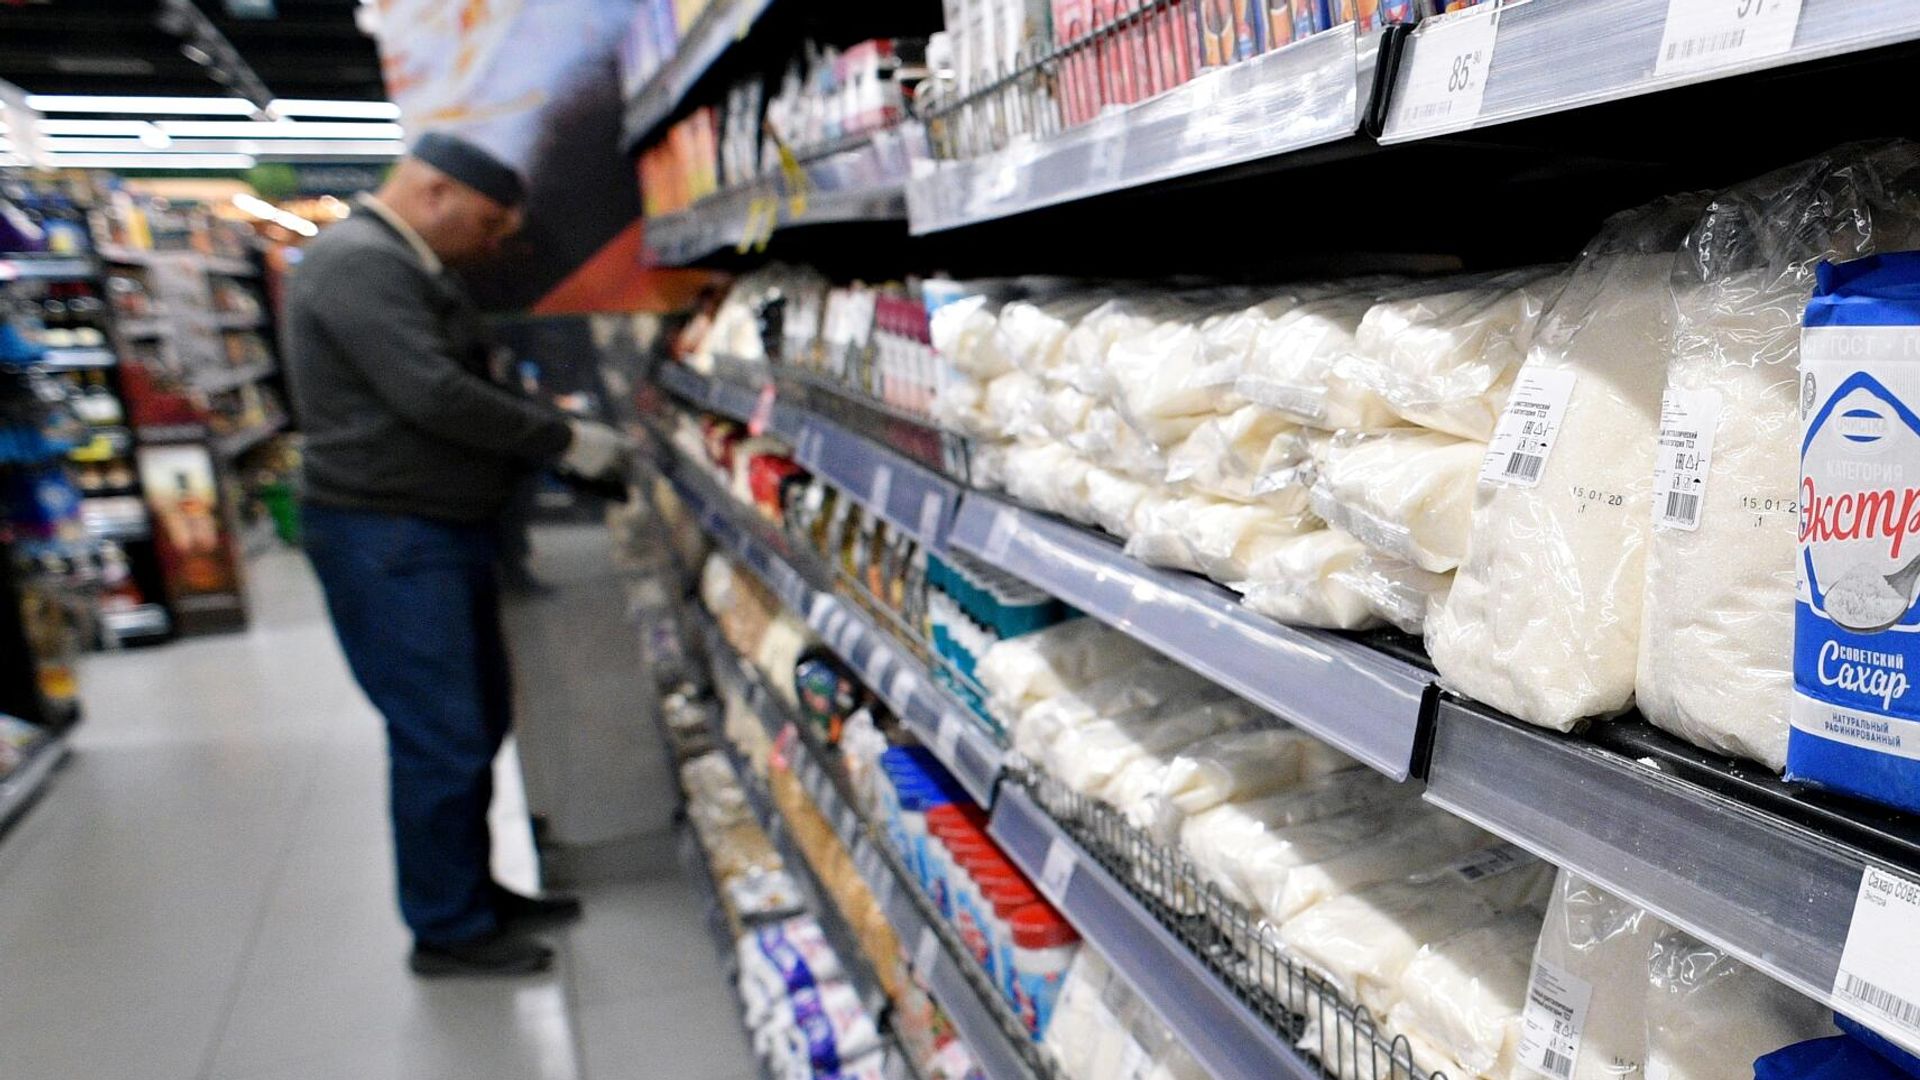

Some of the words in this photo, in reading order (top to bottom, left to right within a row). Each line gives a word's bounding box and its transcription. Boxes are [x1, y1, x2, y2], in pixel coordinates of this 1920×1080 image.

[1448, 55, 1472, 92] 85
[1831, 334, 1880, 357] ГОСТ
[1826, 459, 1904, 482] КАТЕГОРИЯ
[1572, 486, 1622, 506] 15.01.20
[1743, 497, 1798, 514] 15.01.2
[1840, 645, 1904, 670] СОВЕТСКИЙ
[1818, 639, 1911, 711] Сахар
[1824, 721, 1901, 747] РАФИНИРОВАННЫЙ
[1832, 712, 1889, 733] НАТУРАЛЬНЫЙ
[1868, 871, 1894, 896] Сахар
[1894, 881, 1920, 906] СОВЕ
